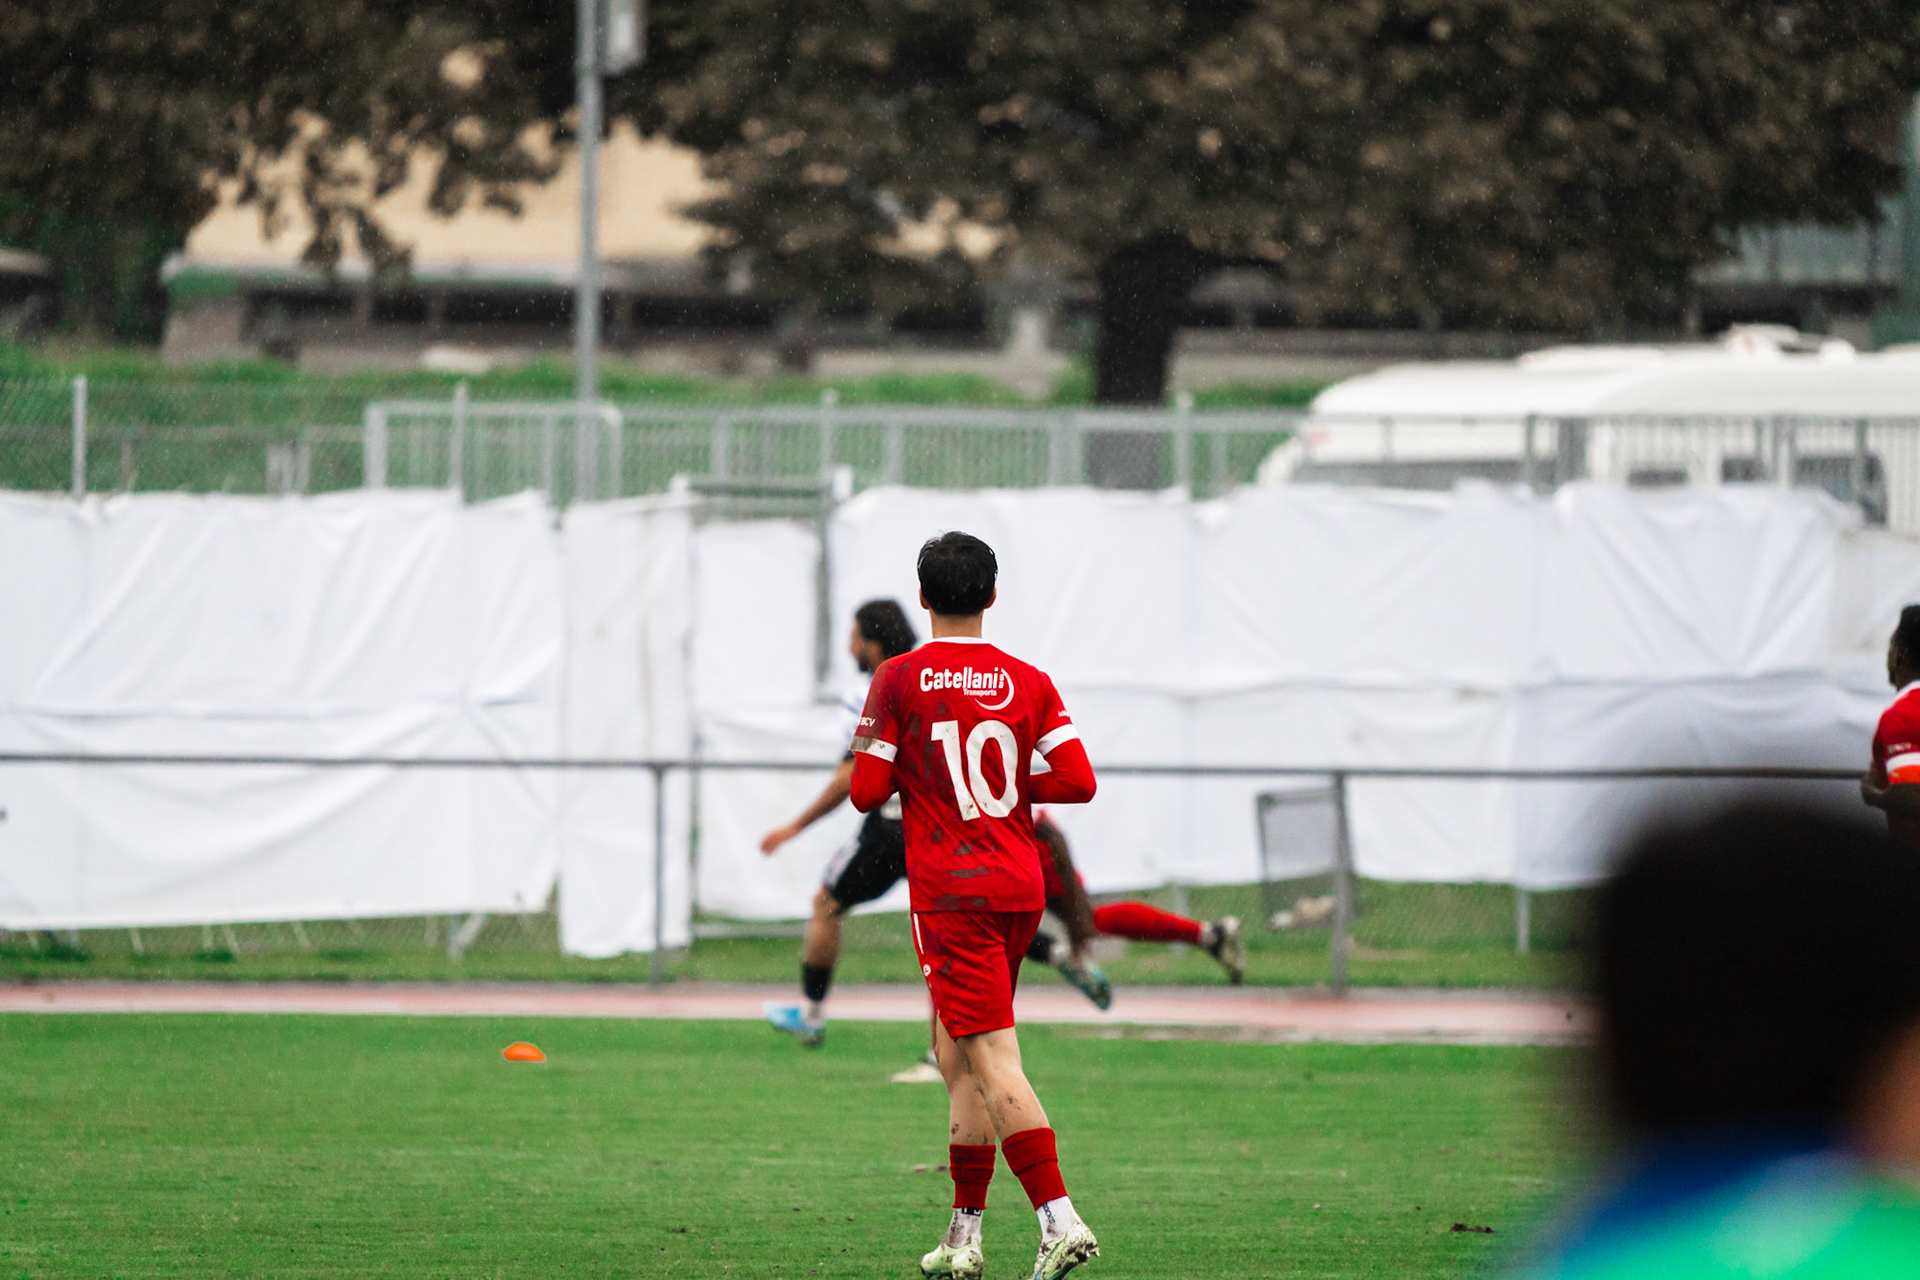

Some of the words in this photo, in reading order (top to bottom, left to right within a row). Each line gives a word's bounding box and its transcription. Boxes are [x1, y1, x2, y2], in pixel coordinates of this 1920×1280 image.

[920, 666, 999, 692] Catellani
[963, 689, 997, 697] Transports
[860, 716, 876, 727] BCV
[931, 720, 1018, 821] 10
